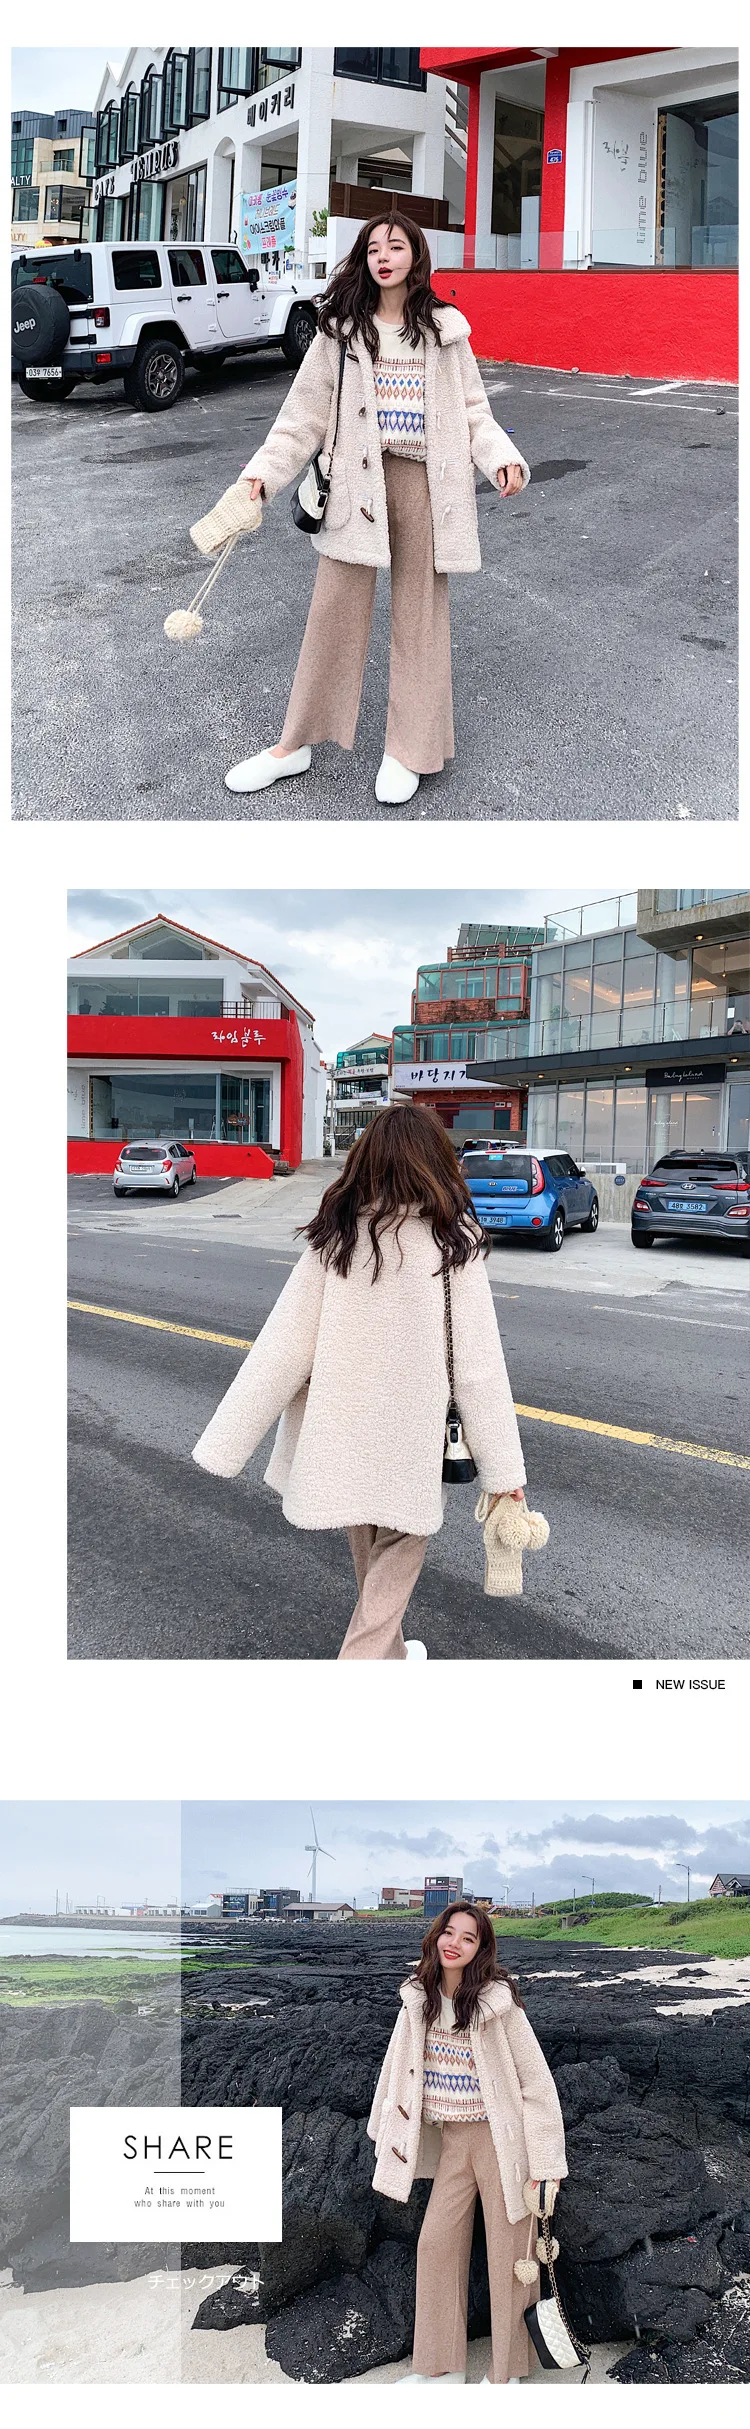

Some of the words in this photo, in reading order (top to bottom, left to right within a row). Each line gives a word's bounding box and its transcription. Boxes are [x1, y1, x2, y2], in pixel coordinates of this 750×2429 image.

[246, 83, 295, 127] 베이커리
[131, 141, 178, 182] TEMPUS
[250, 217, 286, 235] 아이스크림와플
[13, 318, 36, 333] Jeep
[42, 368, 59, 377] 7656
[686, 1203, 704, 1211] 3582
